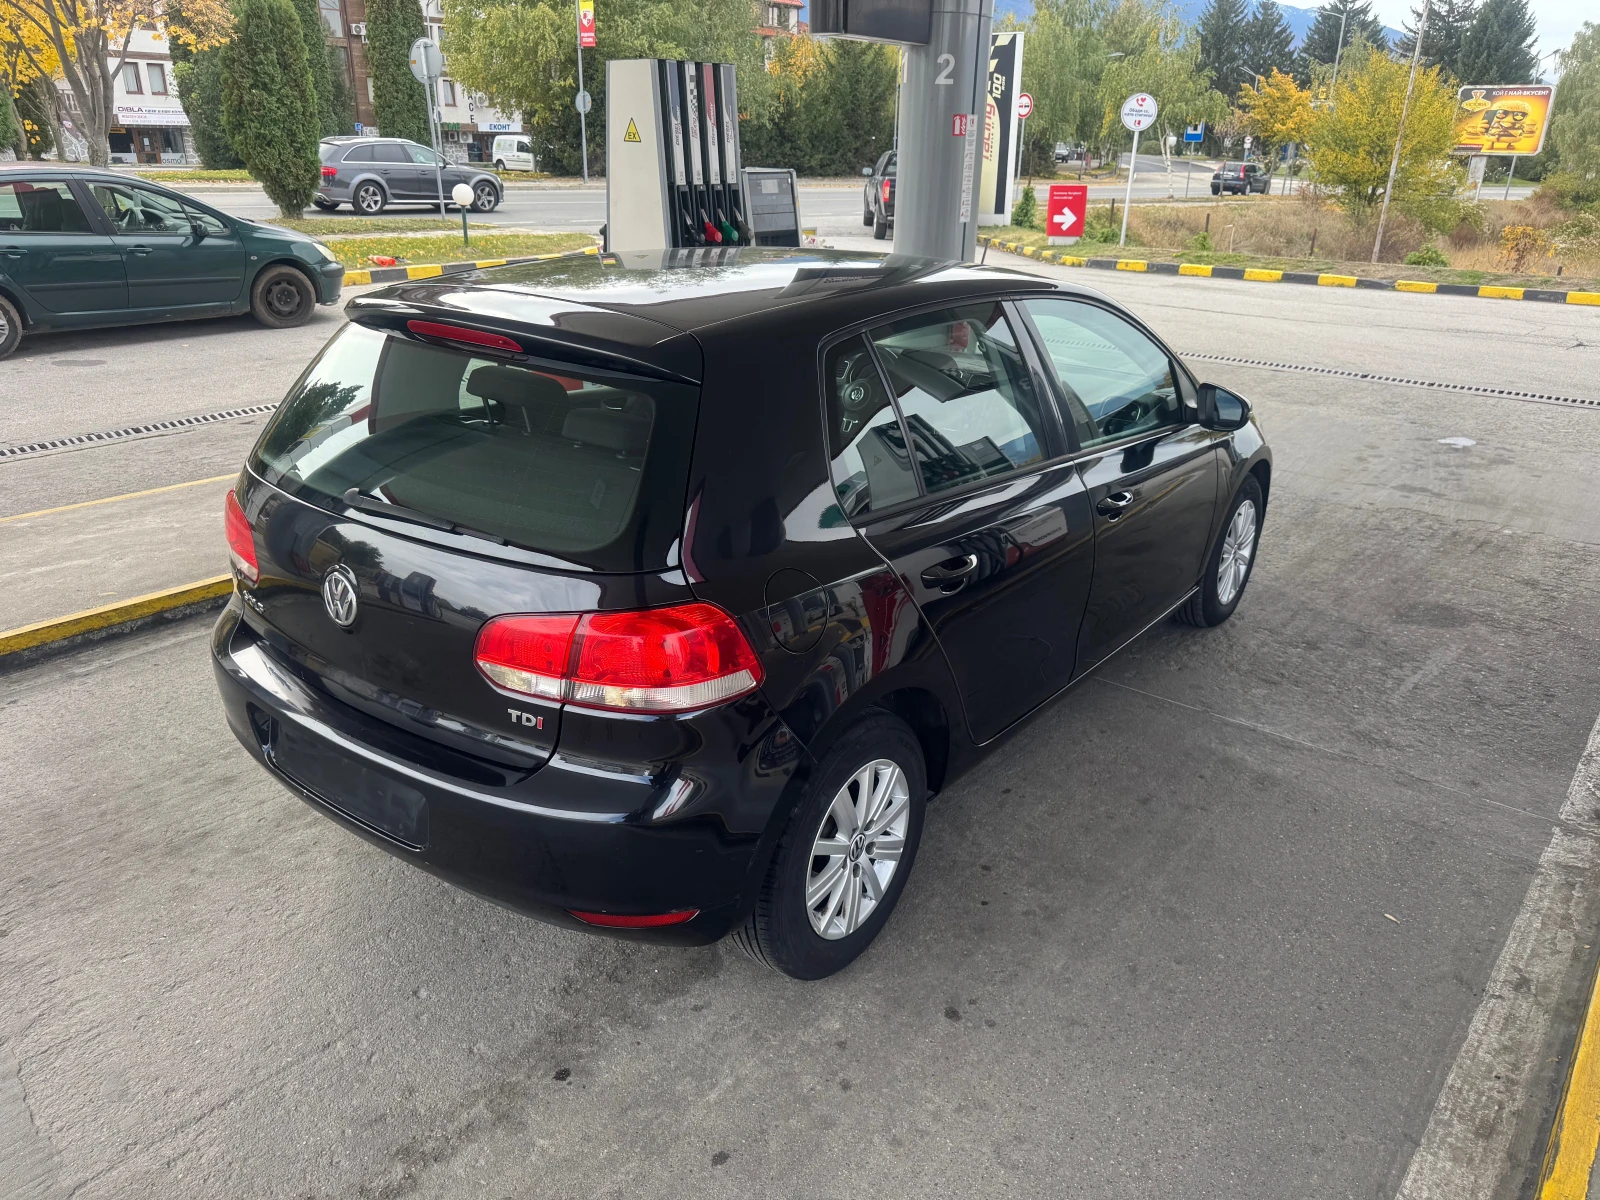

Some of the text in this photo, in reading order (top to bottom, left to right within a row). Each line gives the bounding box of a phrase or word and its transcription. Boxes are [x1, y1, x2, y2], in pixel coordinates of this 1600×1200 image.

[934, 53, 956, 85] 2
[992, 72, 1002, 99] 100
[627, 131, 637, 140] EX
[507, 708, 544, 730] TDI
